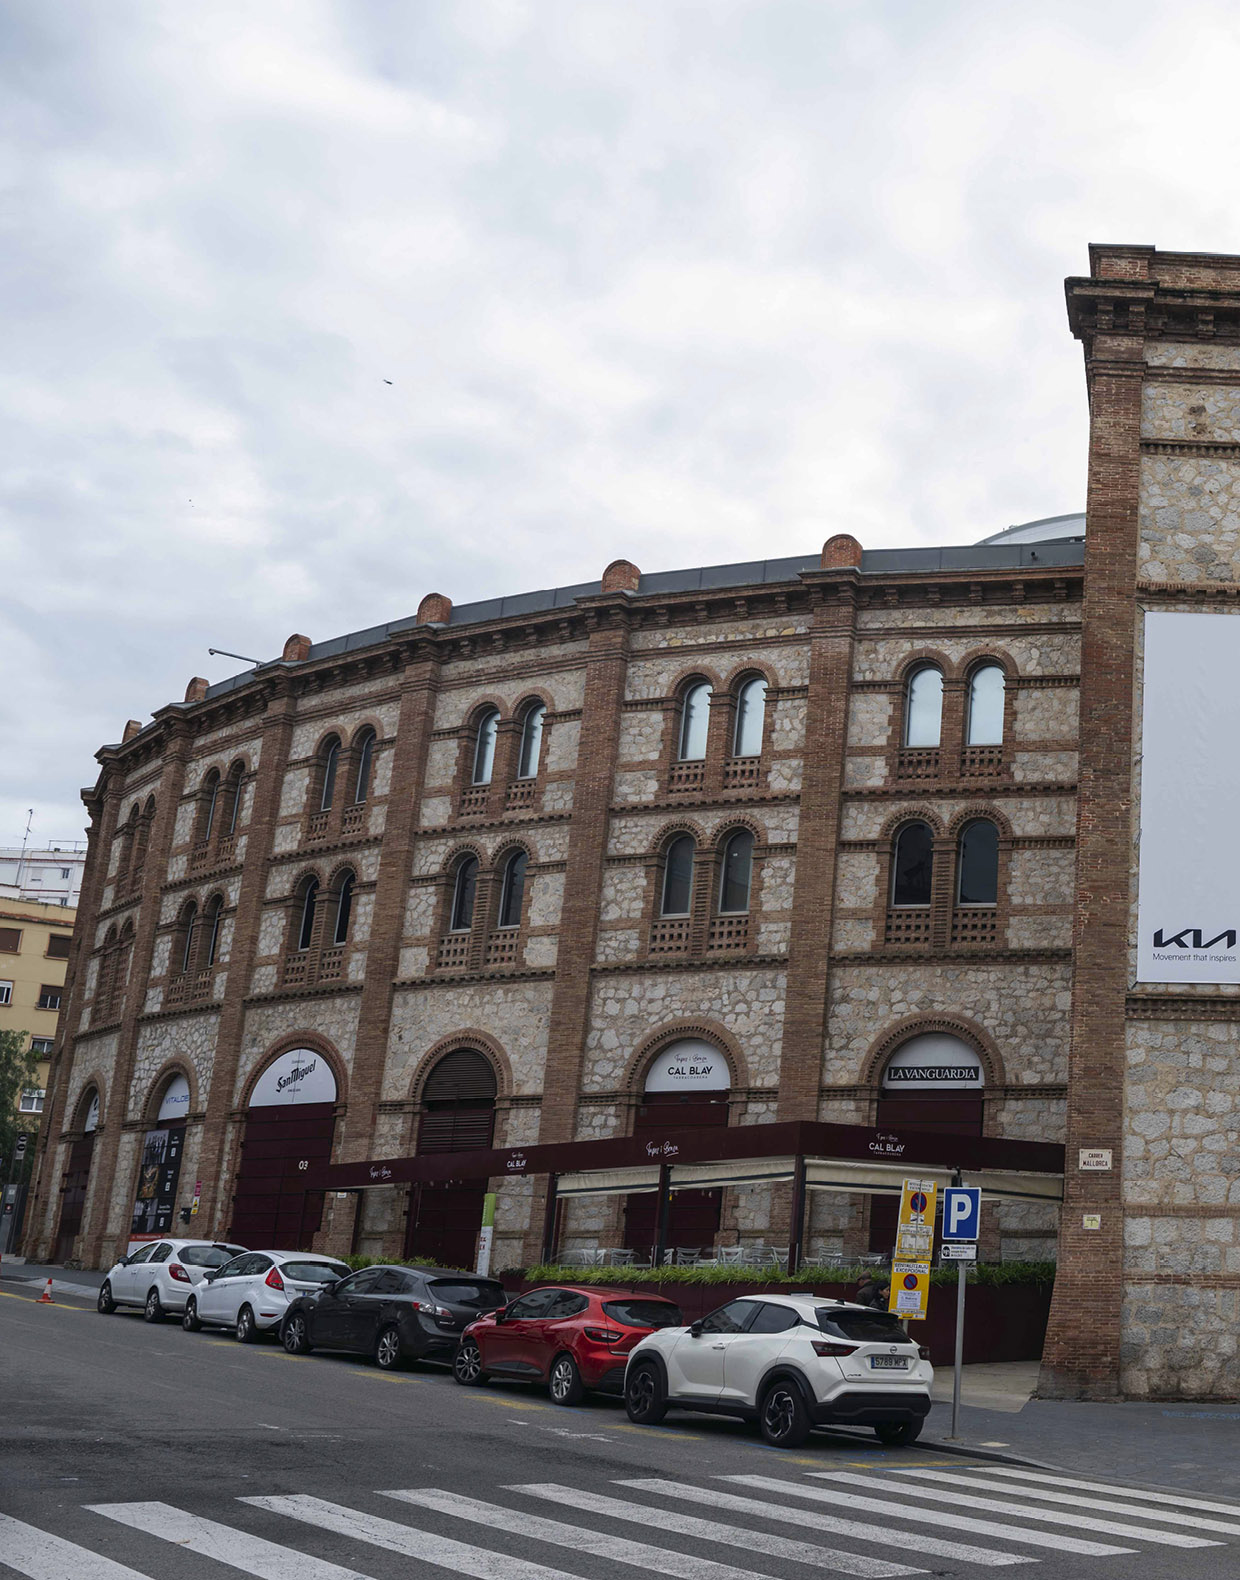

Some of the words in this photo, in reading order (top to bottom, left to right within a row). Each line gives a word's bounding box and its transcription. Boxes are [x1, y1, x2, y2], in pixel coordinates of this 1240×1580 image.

[1153, 928, 1237, 949] KIA
[1152, 953, 1191, 961] Movement
[1193, 953, 1208, 962] that
[1209, 954, 1237, 964] inspires
[668, 1066, 687, 1076] CAL
[688, 1066, 714, 1075] BLAY
[905, 1068, 977, 1079] VANGUARDIA
[868, 1142, 884, 1151] CAL
[886, 1143, 905, 1153] BLAY
[298, 1160, 309, 1171] 03
[949, 1194, 973, 1234] P
[875, 1356, 893, 1367] 5789
